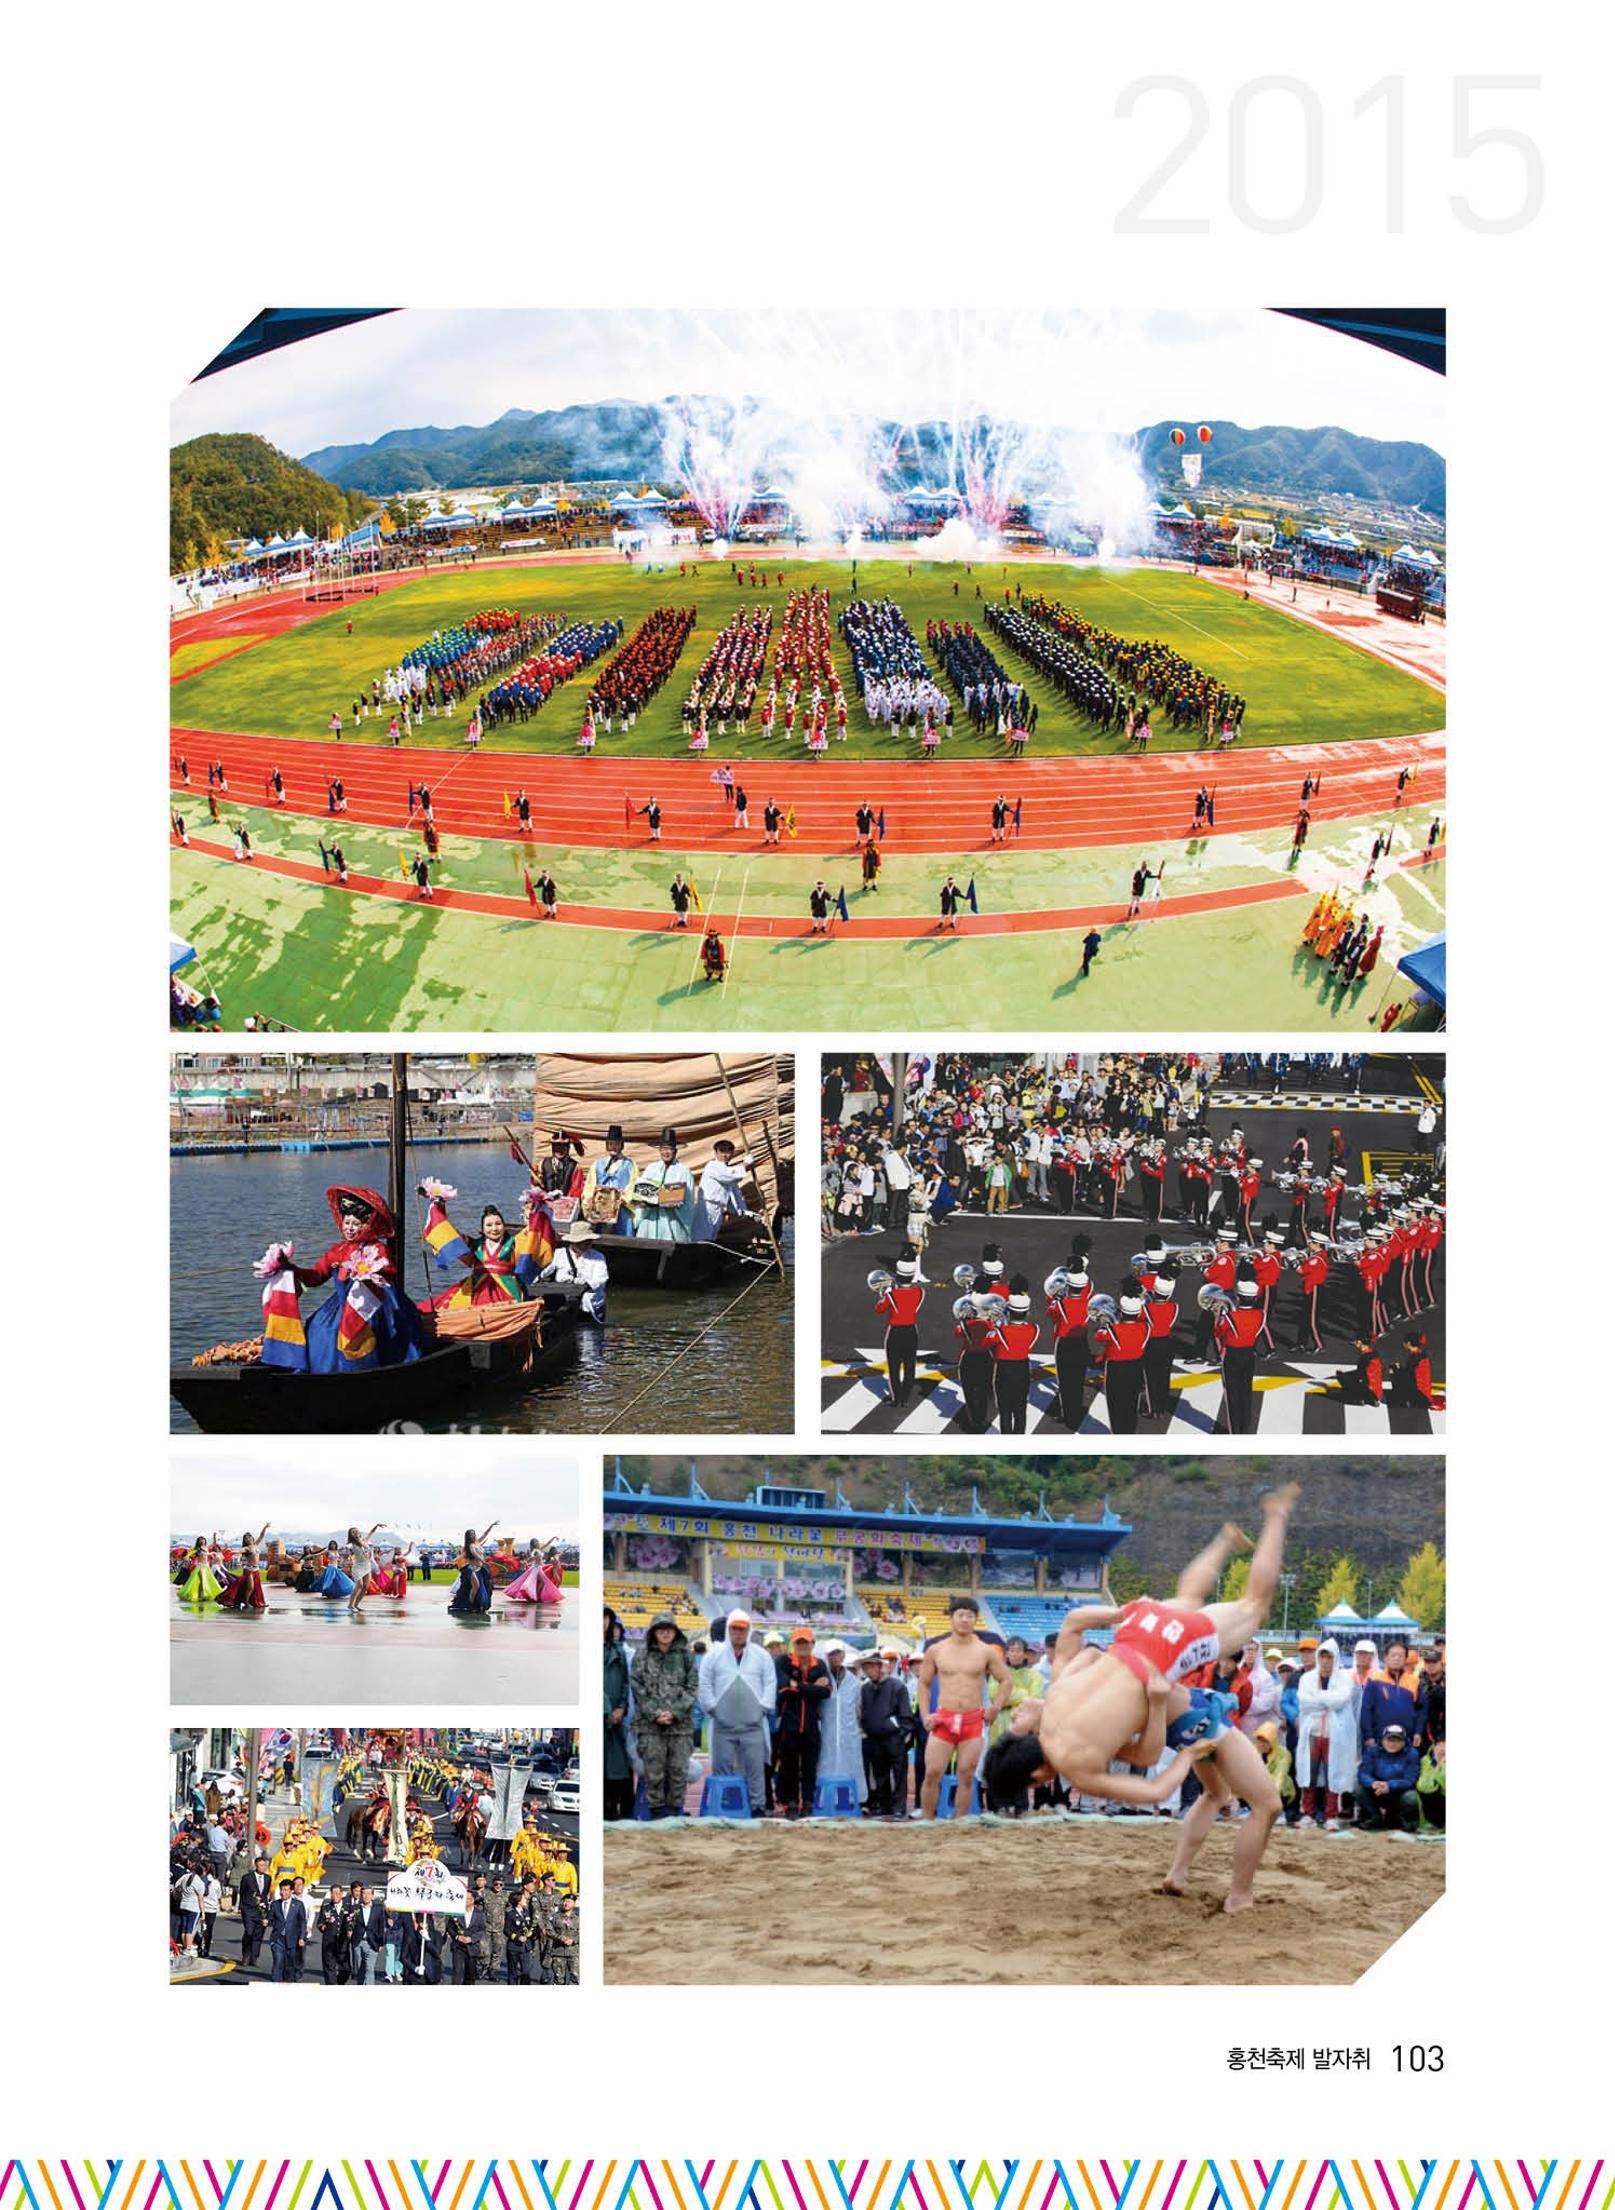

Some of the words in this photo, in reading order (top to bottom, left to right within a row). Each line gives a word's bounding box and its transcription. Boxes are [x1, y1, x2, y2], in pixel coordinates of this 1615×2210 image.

[1113, 74, 1545, 235] 2015
[659, 1515, 710, 1535] 제7회
[723, 1520, 757, 1539] 홍천
[414, 1864, 444, 1879] 제7회
[1226, 2047, 1305, 2071] 홍천축제
[1312, 2047, 1370, 2071] 발자취
[1392, 2044, 1444, 2072] 103
